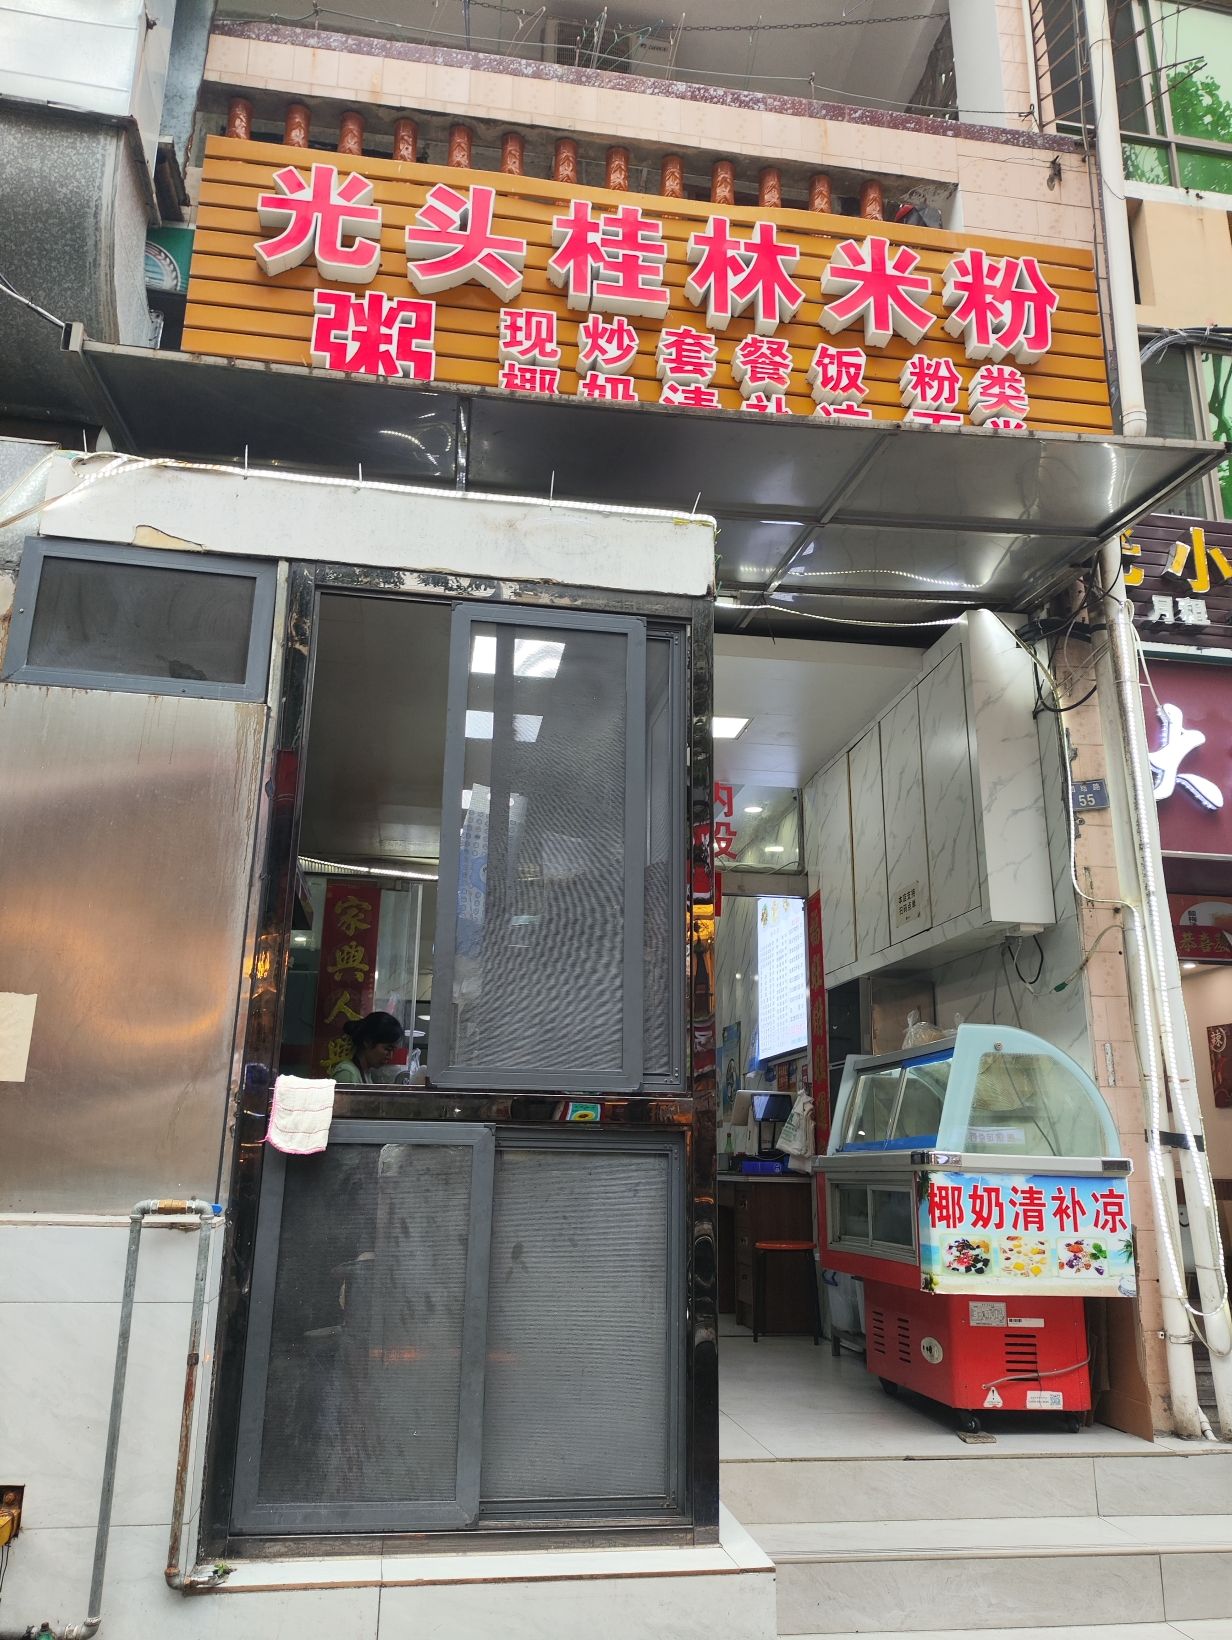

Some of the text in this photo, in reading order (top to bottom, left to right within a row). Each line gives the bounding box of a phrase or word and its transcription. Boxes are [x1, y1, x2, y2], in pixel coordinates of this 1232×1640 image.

[254, 163, 1060, 362] 光头桂林米粉
[311, 288, 436, 381] 粥
[499, 307, 1030, 420] 现炒套餐饭 粉类
[1078, 793, 1096, 807] 55
[928, 1182, 1129, 1234] 椰奶清补凉
